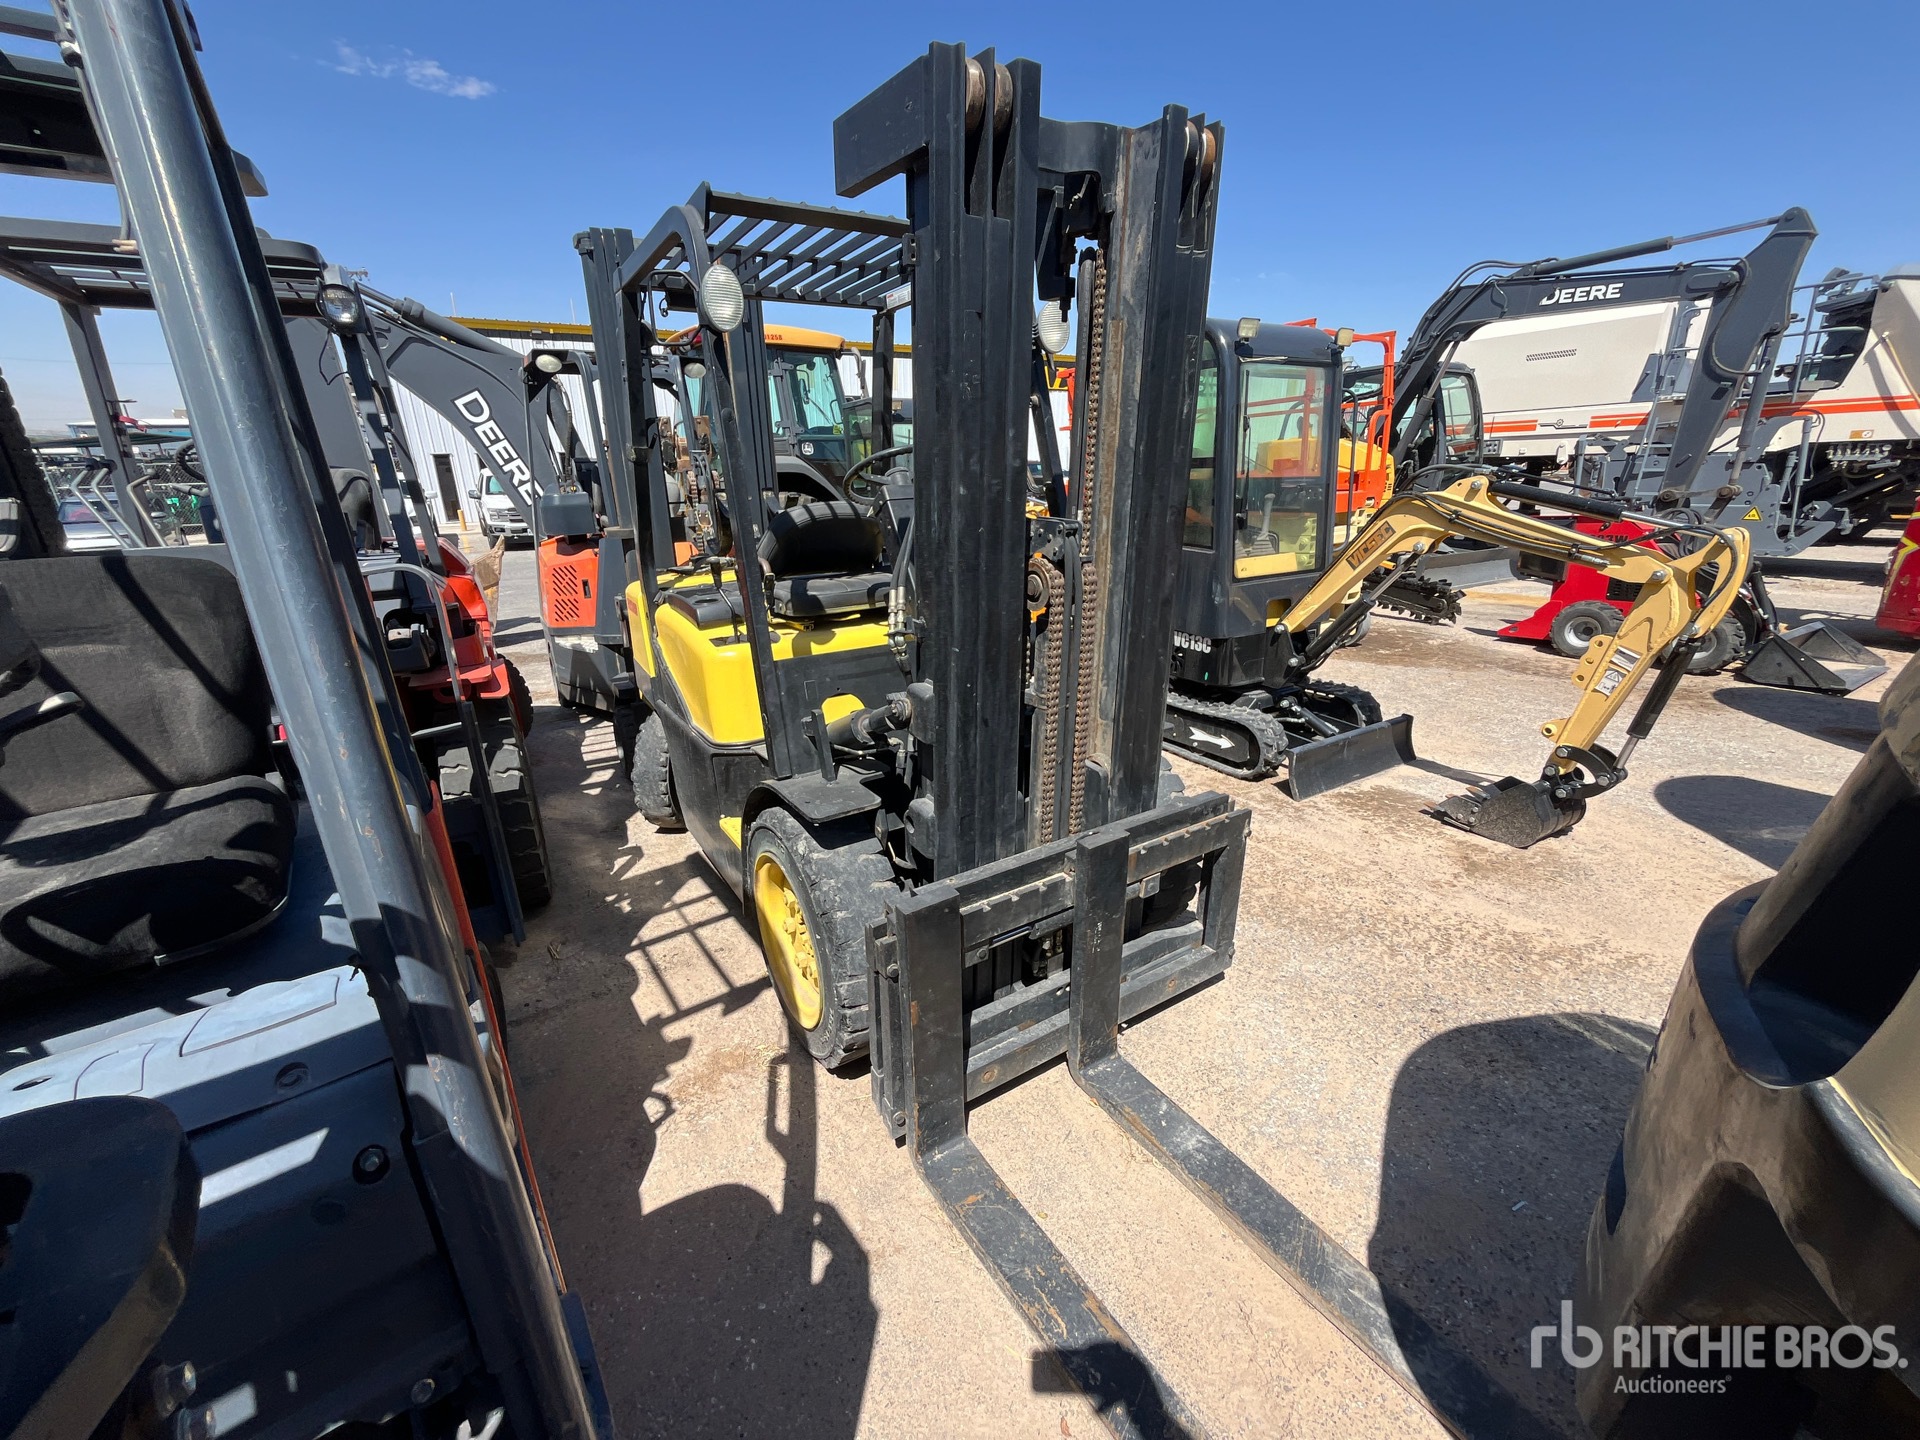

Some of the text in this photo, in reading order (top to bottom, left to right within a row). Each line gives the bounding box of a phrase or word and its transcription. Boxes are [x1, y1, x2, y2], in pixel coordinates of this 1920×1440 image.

[1538, 283, 1624, 306] DEERE
[453, 389, 545, 506] DEERE
[1173, 630, 1212, 654] VC13C
